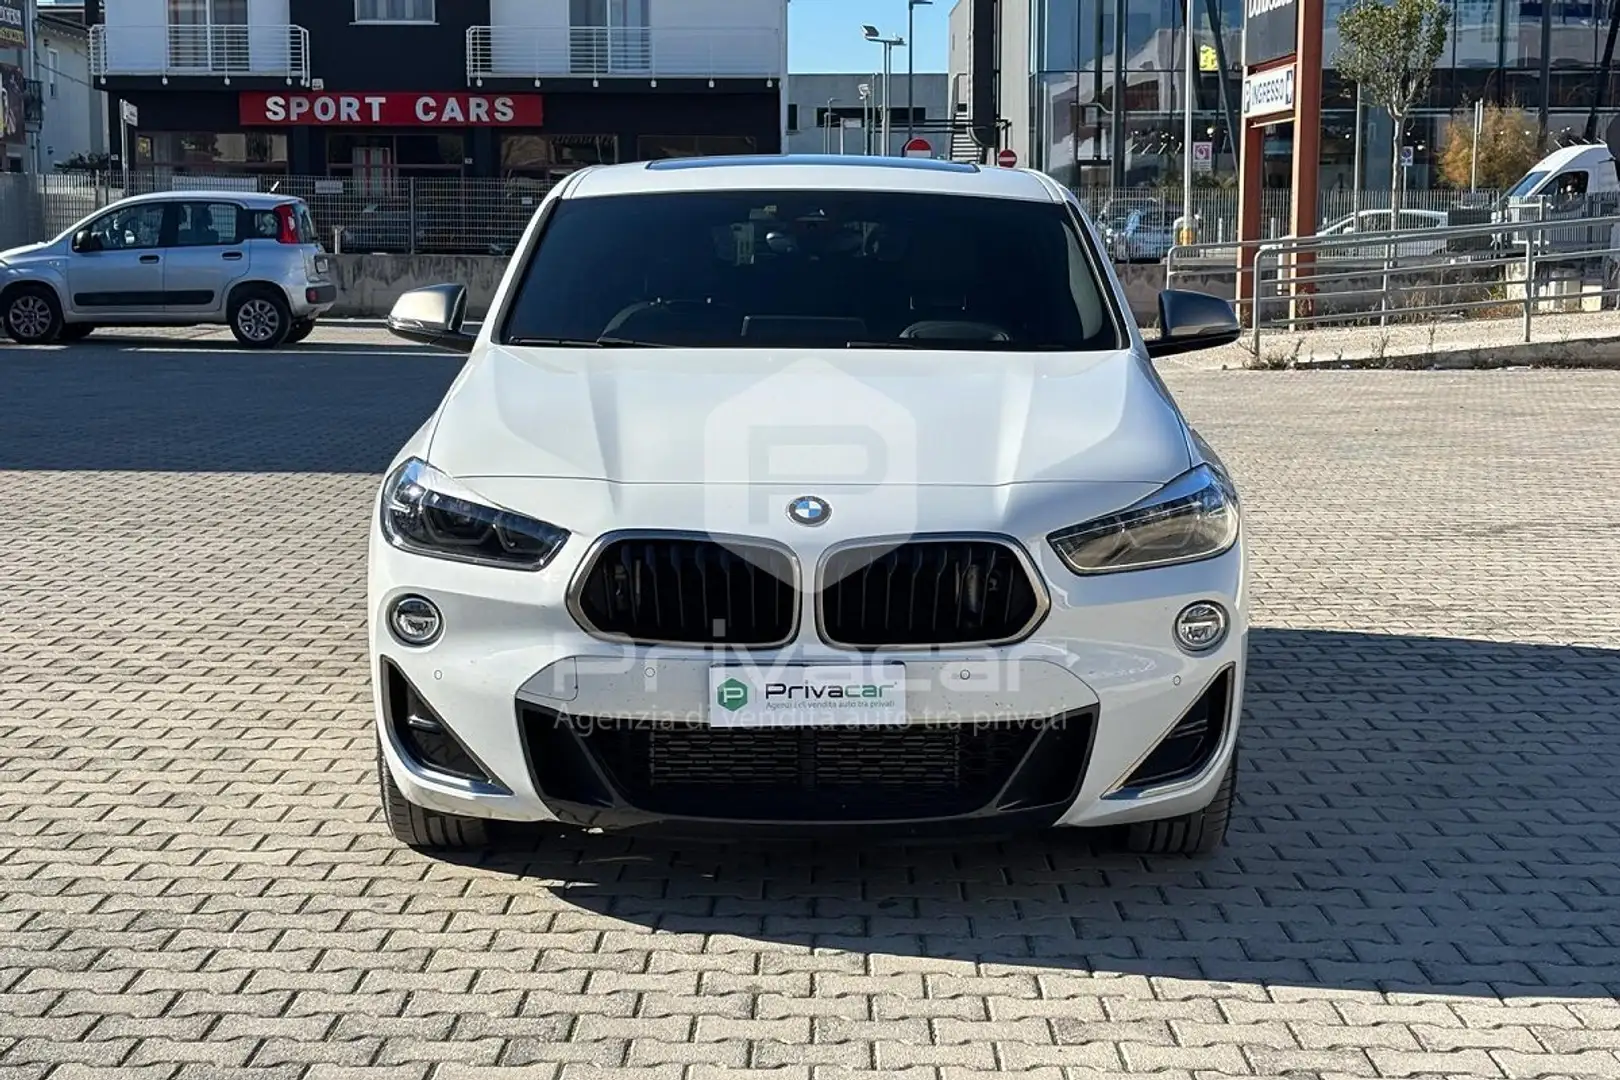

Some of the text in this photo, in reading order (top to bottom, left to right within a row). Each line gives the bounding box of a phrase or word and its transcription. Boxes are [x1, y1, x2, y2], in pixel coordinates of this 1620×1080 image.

[1251, 78, 1285, 106] INGRESSO
[265, 96, 515, 122] SPORT CARS
[765, 679, 895, 700] Privacar
